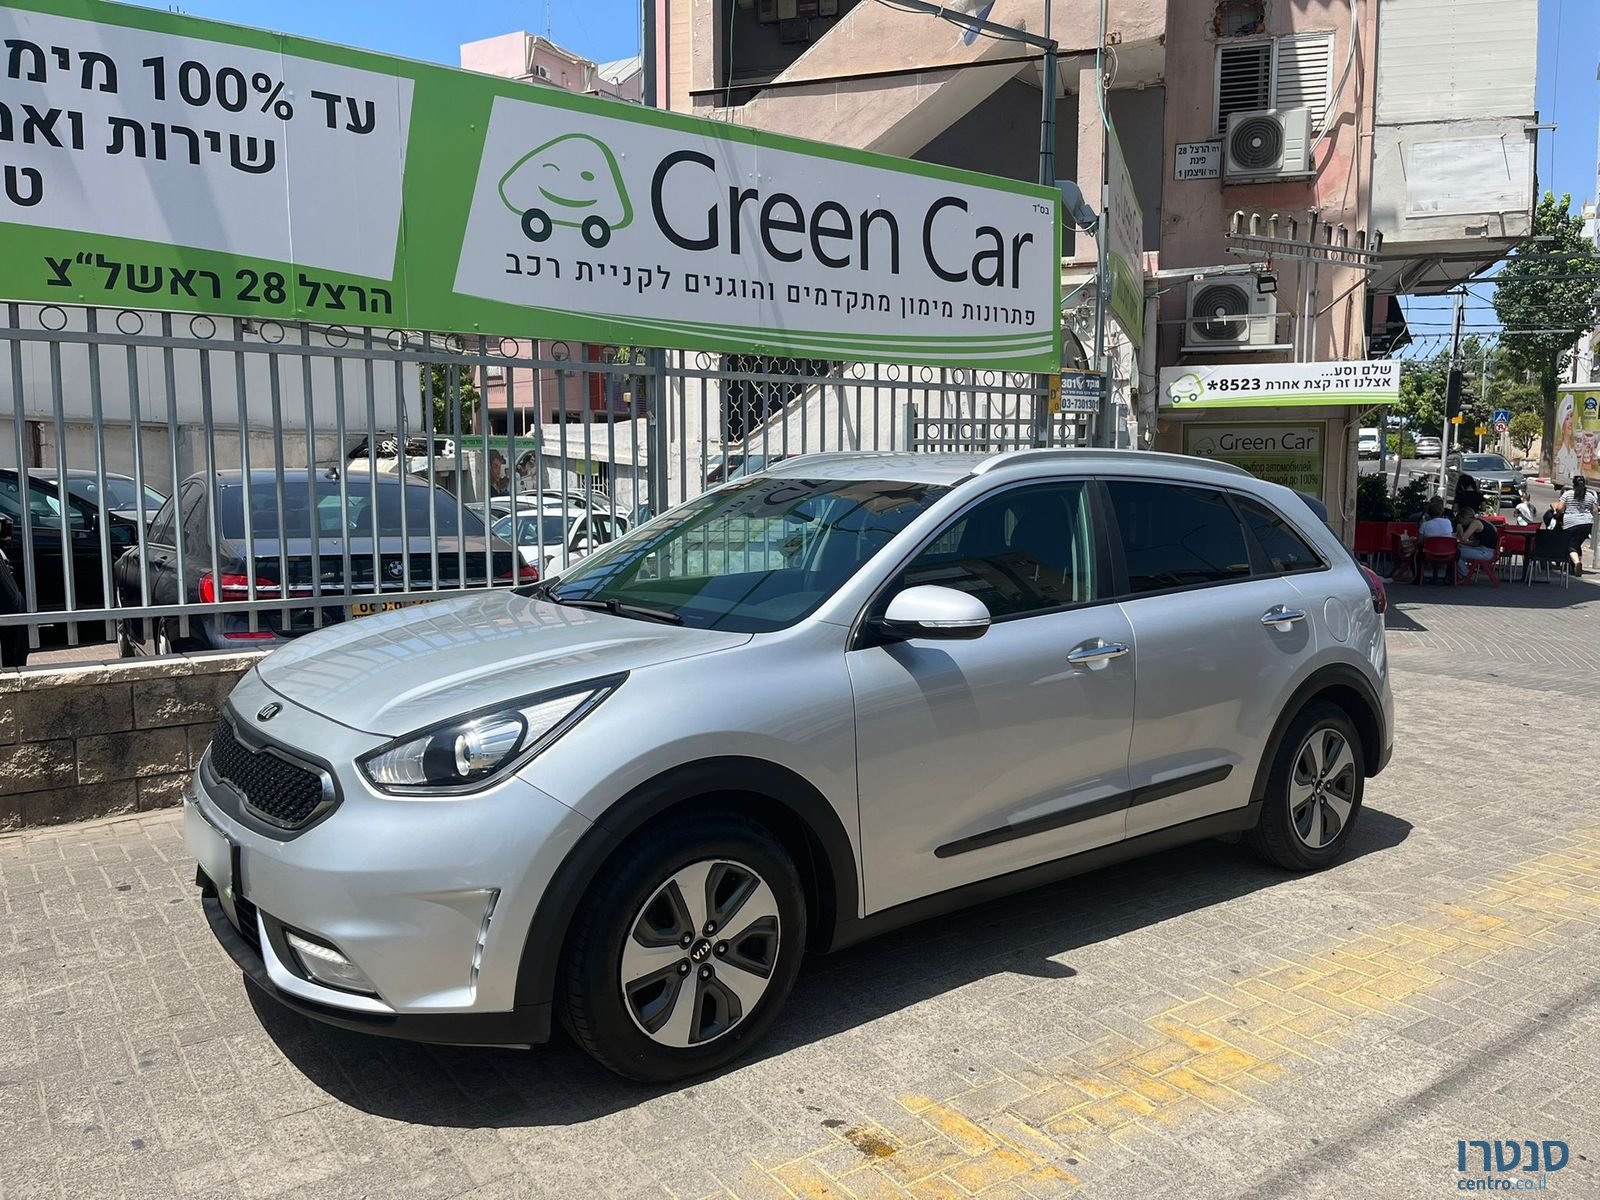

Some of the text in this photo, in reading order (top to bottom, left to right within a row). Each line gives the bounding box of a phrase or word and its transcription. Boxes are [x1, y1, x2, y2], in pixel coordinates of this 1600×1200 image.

[143, 56, 293, 121] 100%
[311, 91, 375, 134] עד
[107, 117, 275, 173] שירות
[1178, 147, 1187, 155] 28
[1190, 145, 1209, 154] הרצל
[1190, 157, 1206, 165] פינת
[650, 150, 899, 274] Green
[923, 197, 1033, 288] Car
[236, 270, 286, 304] 28
[506, 253, 1035, 326] פתרונות מימון מתקדמים והוגנים לקניית רכב
[299, 274, 393, 314] הרצל
[1362, 364, 1391, 375] שלם
[1062, 379, 1076, 388] 301
[1265, 380, 1300, 390] אחרת
[1304, 380, 1331, 391] קצת
[1335, 379, 1350, 388] זה
[1355, 376, 1391, 388] אצלנו
[1220, 433, 1314, 450] Green Car
[1300, 473, 1319, 485] 100%
